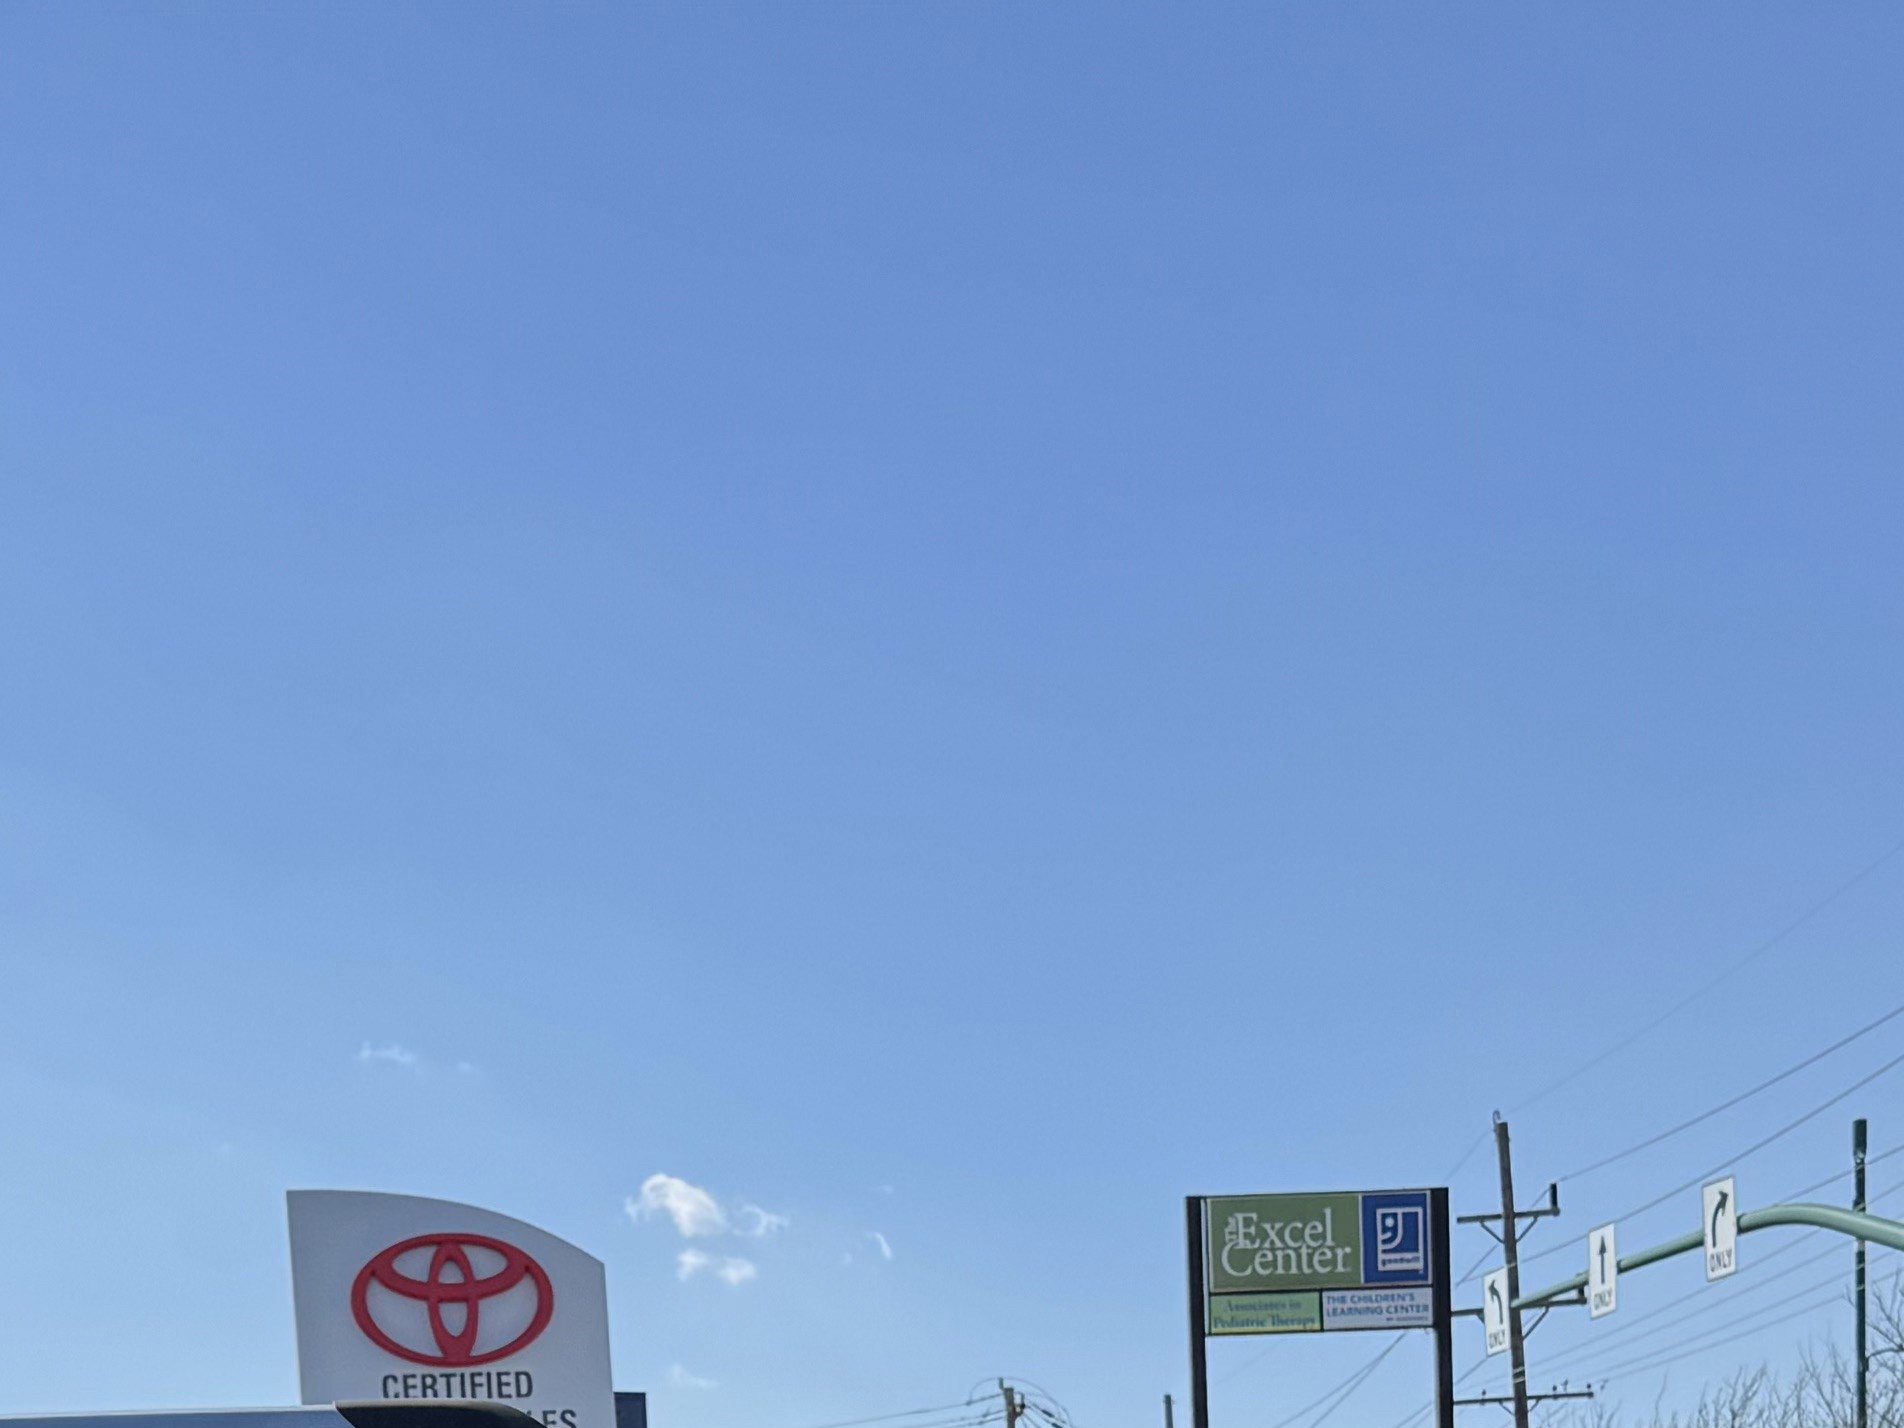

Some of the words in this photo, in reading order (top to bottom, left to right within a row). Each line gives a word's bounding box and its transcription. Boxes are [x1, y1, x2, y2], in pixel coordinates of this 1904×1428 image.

[1232, 1206, 1336, 1250] Excel
[1221, 1241, 1352, 1277] Center
[1327, 1295, 1347, 1304] THE
[1349, 1293, 1415, 1304] CHILDREN'S
[1327, 1306, 1384, 1317] LEARNING
[1385, 1303, 1430, 1315] CENTER
[1593, 1288, 1613, 1311] ONLY
[382, 1370, 534, 1399] CERTIFIED
